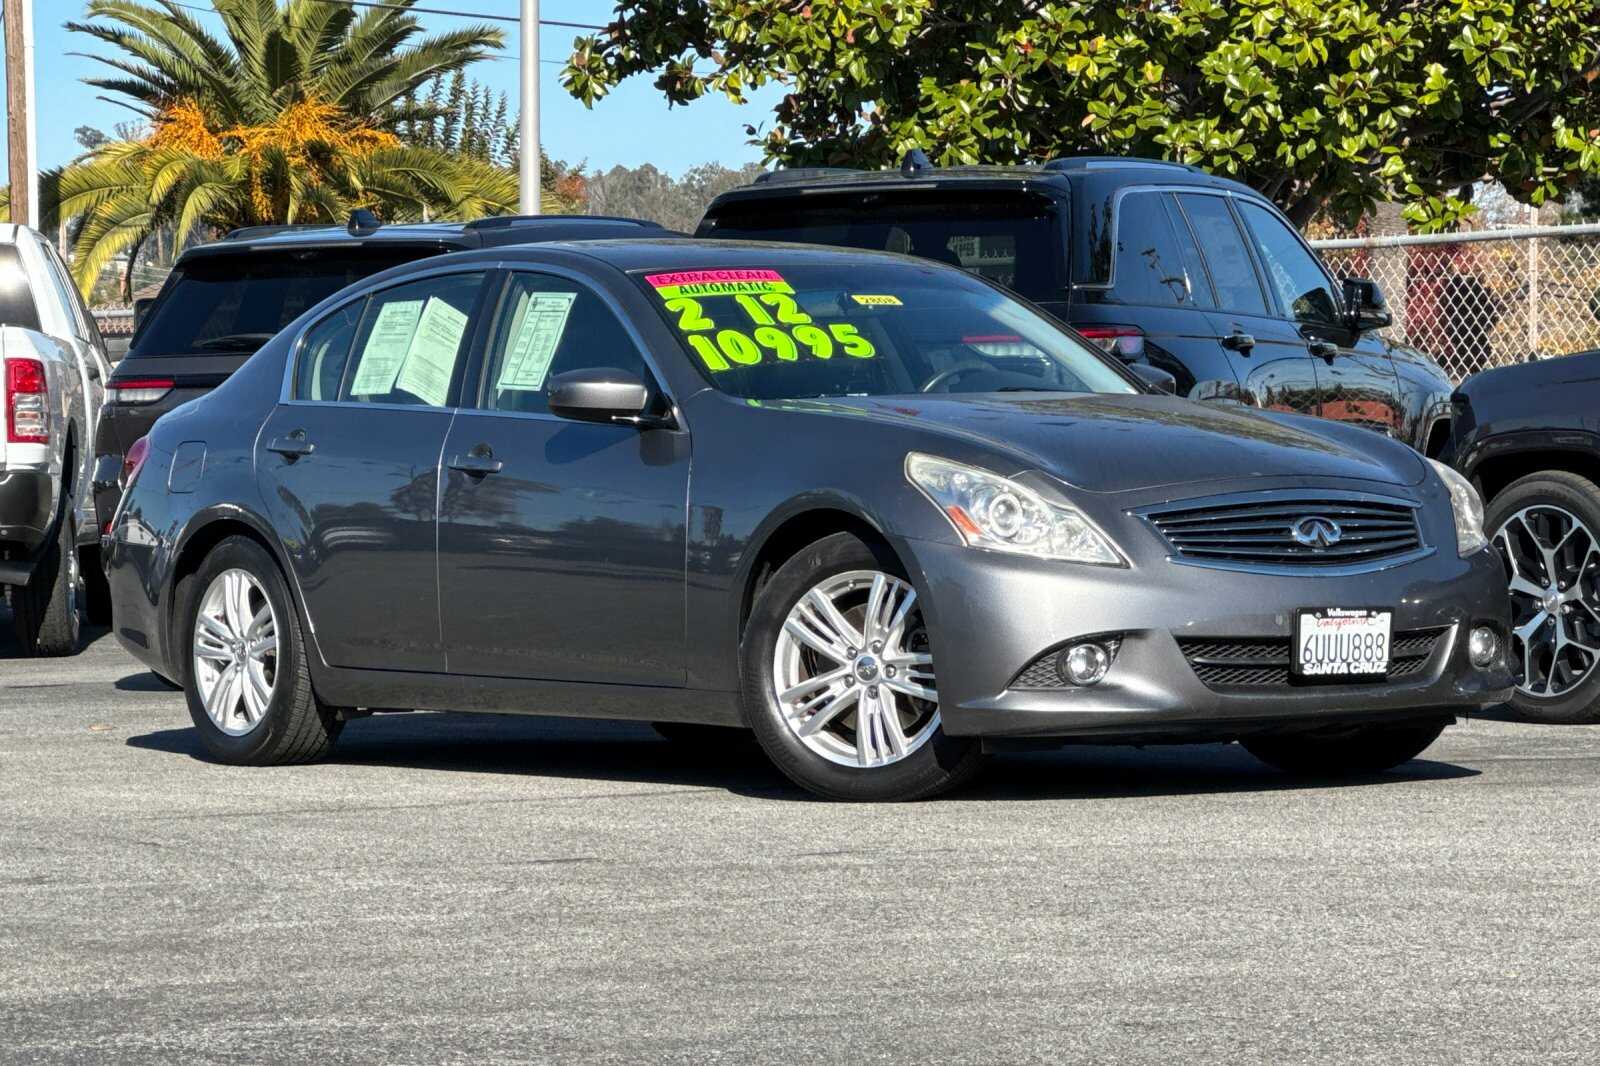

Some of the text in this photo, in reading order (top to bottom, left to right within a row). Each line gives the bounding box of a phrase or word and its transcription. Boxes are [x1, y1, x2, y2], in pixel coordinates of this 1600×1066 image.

[656, 271, 770, 285] EXTRA CLEAN
[679, 282, 773, 295] AUTOMATIC
[687, 324, 875, 371] 10995
[1327, 607, 1367, 618] Volkswagen
[1317, 617, 1369, 631] California
[1303, 633, 1385, 663] 6UUU888
[1302, 662, 1387, 675] SANTA CRUZ
